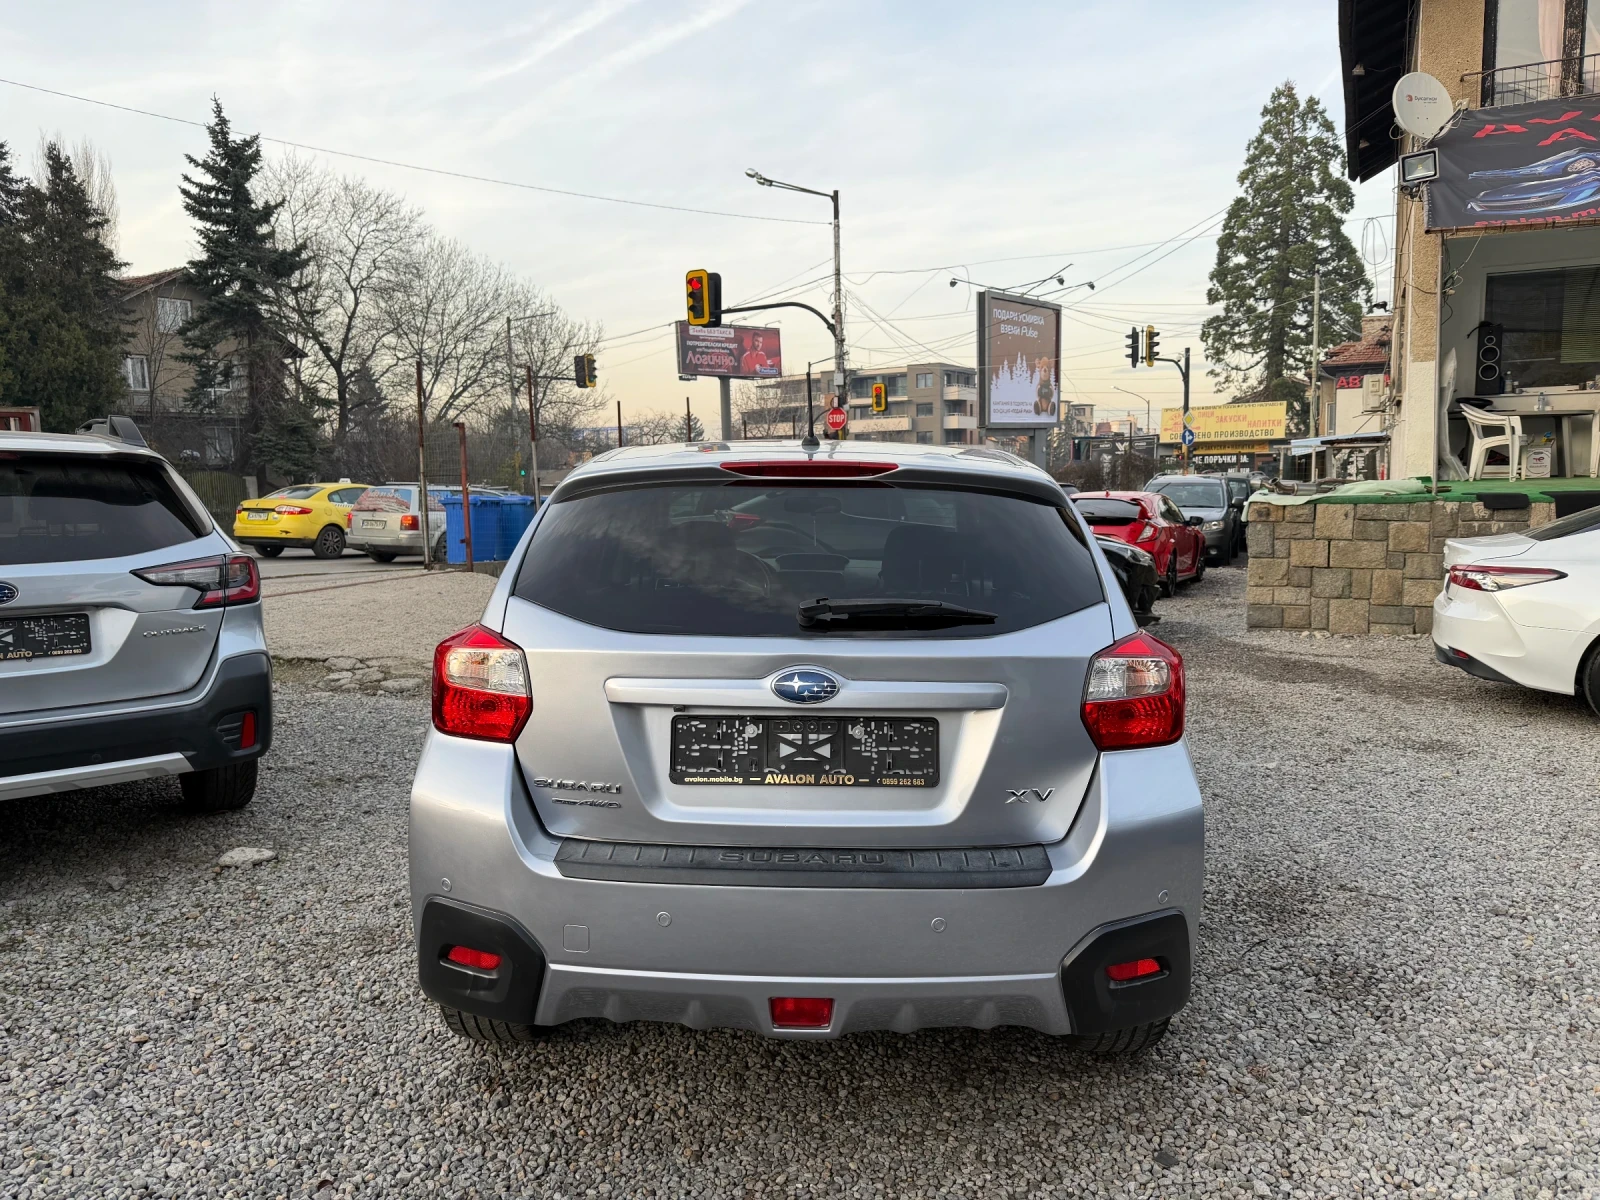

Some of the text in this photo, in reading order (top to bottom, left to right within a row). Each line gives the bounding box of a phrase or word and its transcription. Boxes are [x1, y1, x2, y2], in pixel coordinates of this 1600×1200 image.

[992, 308, 1045, 326] ПОДАРИ УСМИВКА
[1000, 323, 1039, 338] ВЗЕМИ Pulse
[828, 414, 845, 423] STOP
[1215, 414, 1248, 424] ЗАКУСКИ
[1247, 419, 1282, 428] НАПИТКИ
[1214, 428, 1275, 439] ПРОИЗВОДСТВО
[1204, 455, 1237, 464] ПОРЪЧКИ
[143, 624, 206, 638] OUTBACK
[6, 650, 33, 659] AUTO
[684, 776, 744, 784] avalon.mobile.bg
[764, 774, 815, 784] AVALON
[820, 774, 855, 785] AUTO
[899, 777, 912, 785] 262
[534, 777, 622, 794] SUBARU
[1005, 787, 1056, 804] XV
[718, 851, 886, 865] SUBARU
